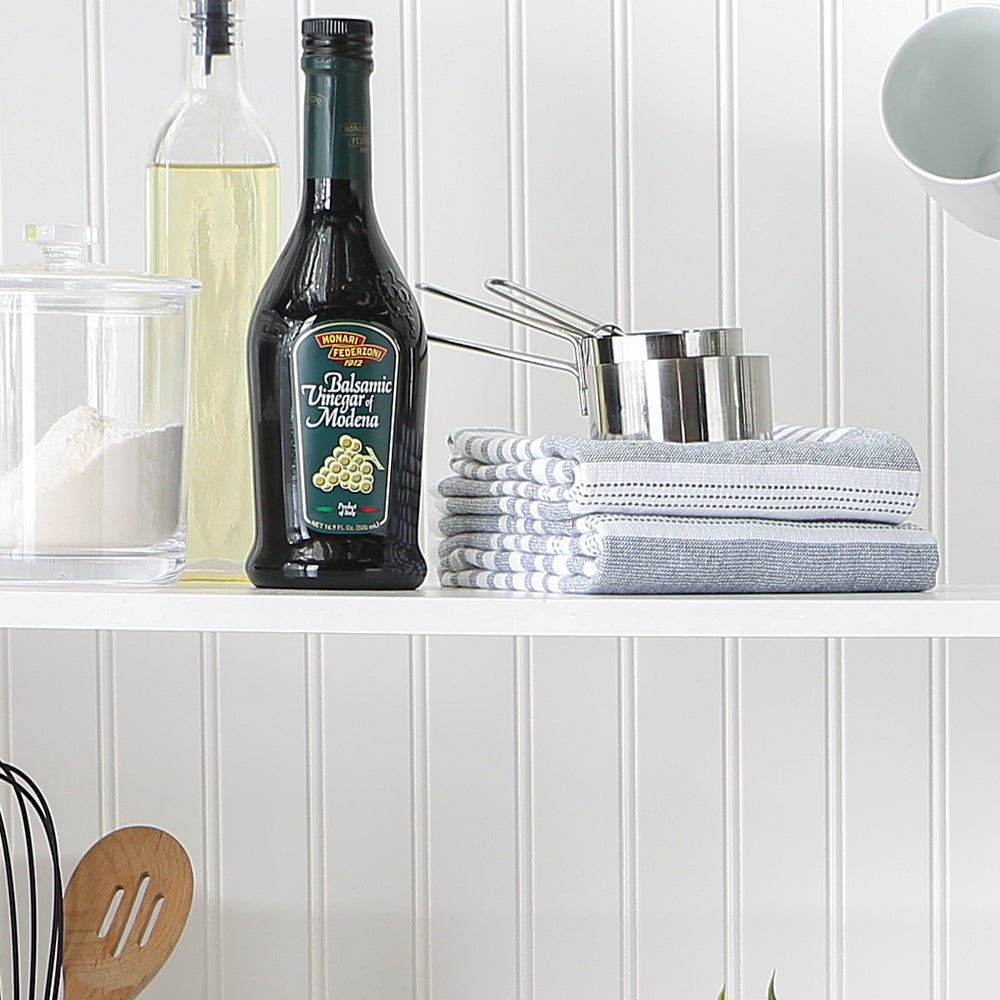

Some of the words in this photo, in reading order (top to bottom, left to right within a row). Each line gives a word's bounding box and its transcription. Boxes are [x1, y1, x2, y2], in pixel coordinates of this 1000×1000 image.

[322, 334, 359, 345] MONARI
[333, 346, 382, 359] FEDERZONI
[343, 359, 364, 367] 1912
[324, 372, 393, 393] Balsamic
[301, 384, 366, 414] Vinegar
[365, 394, 375, 413] of
[305, 406, 380, 428] Modena
[311, 520, 324, 529] NET
